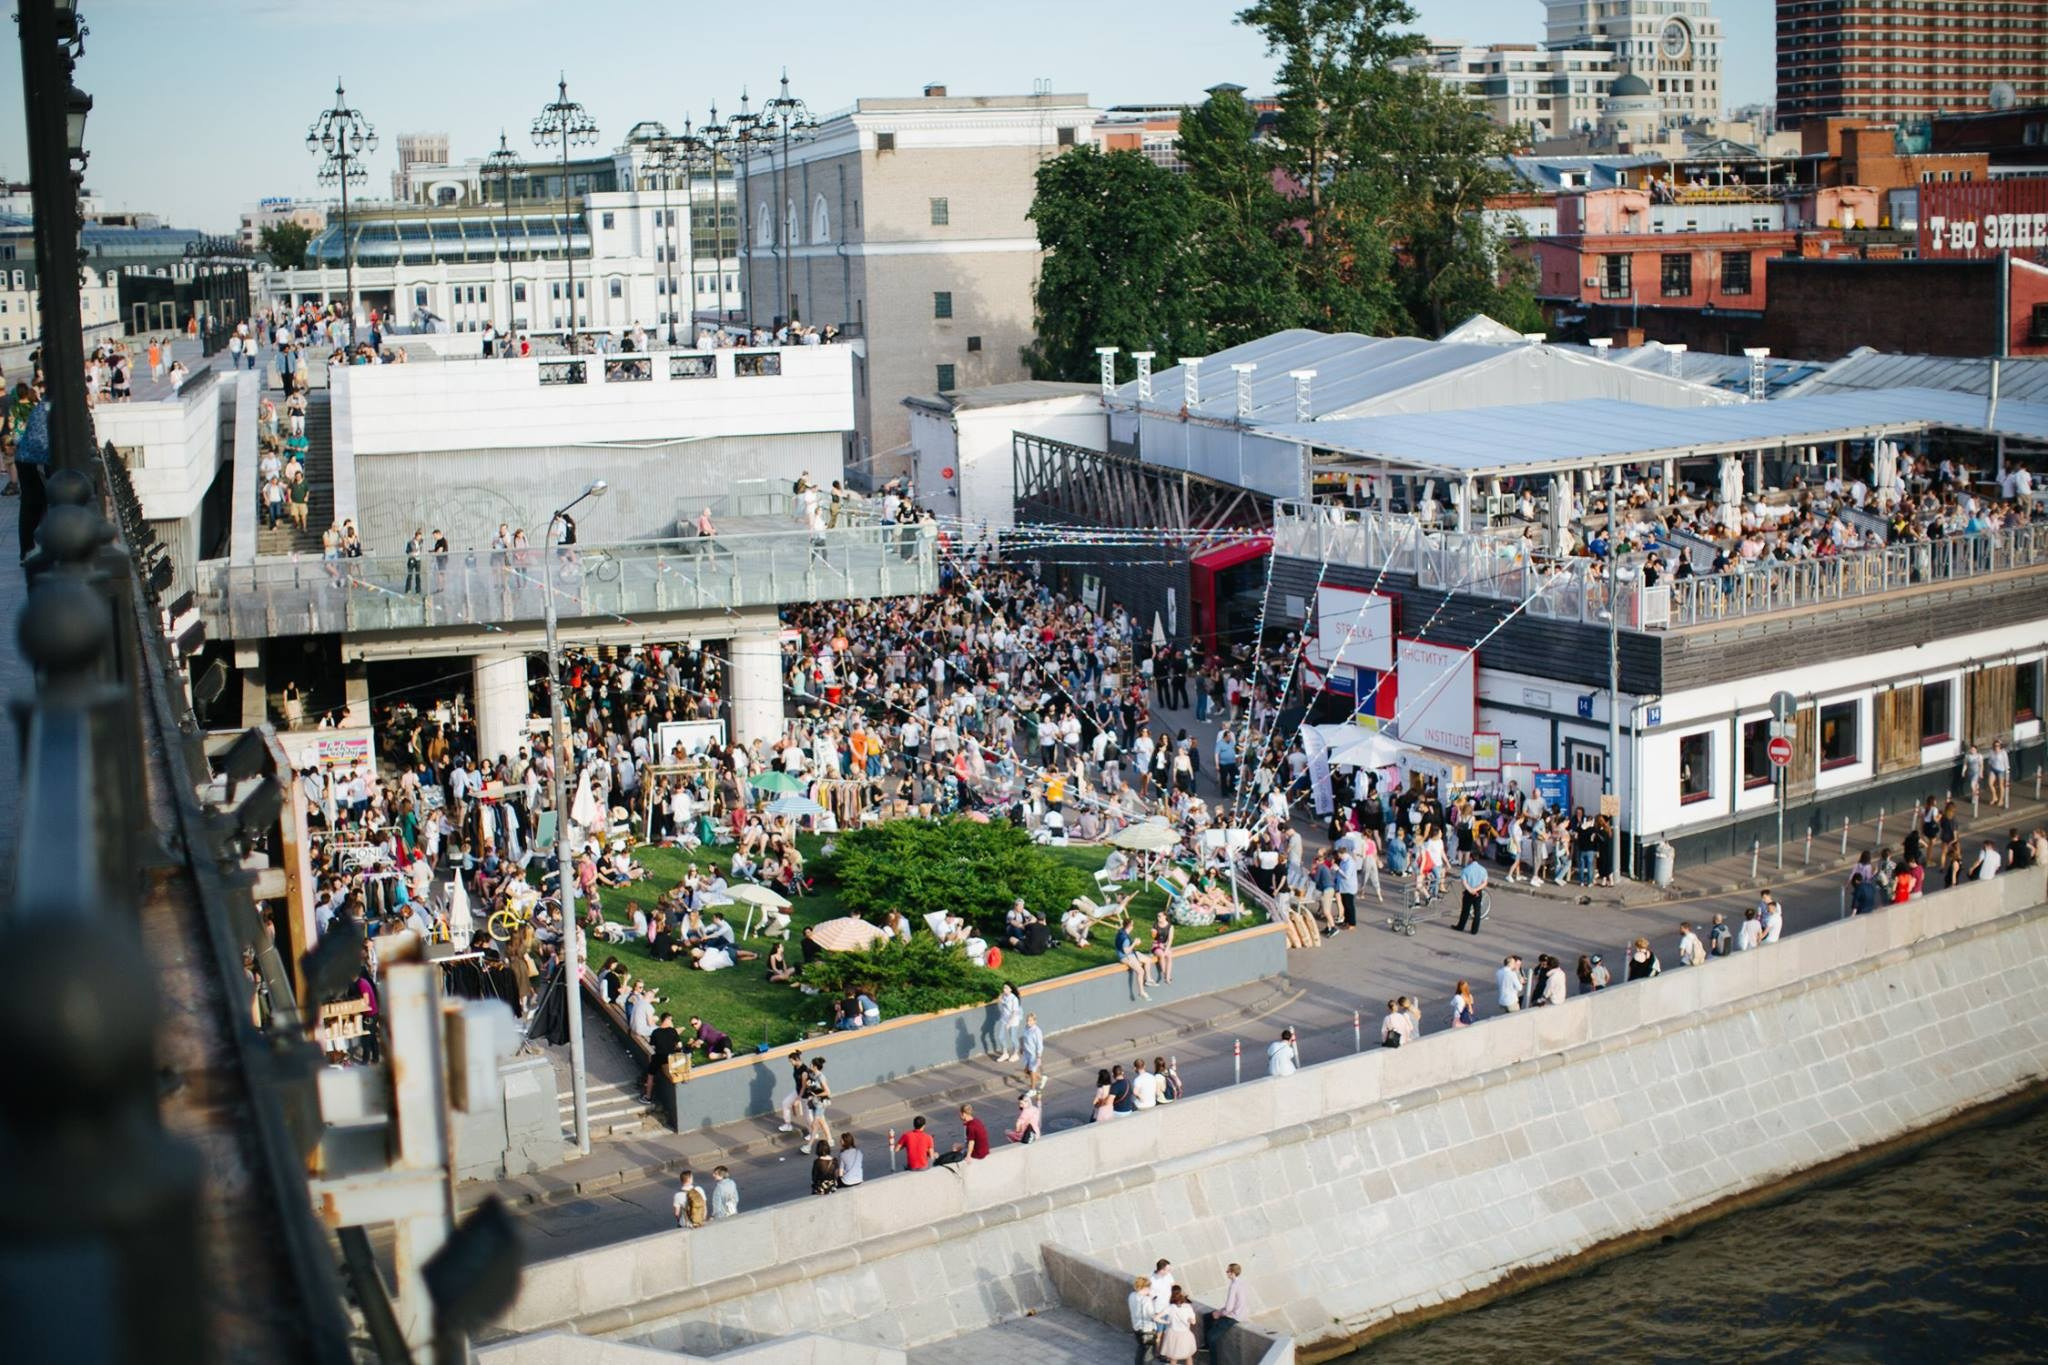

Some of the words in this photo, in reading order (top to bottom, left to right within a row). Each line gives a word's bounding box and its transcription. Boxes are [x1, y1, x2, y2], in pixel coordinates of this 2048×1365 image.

[1984, 213, 2048, 248] ЭЙНЕ
[1335, 622, 1374, 638] STRELKA
[1401, 648, 1449, 666] ИНСТИТУТ
[1580, 700, 1588, 711] 14
[1651, 708, 1660, 720] 14
[1425, 728, 1471, 749] INSTITUTE
